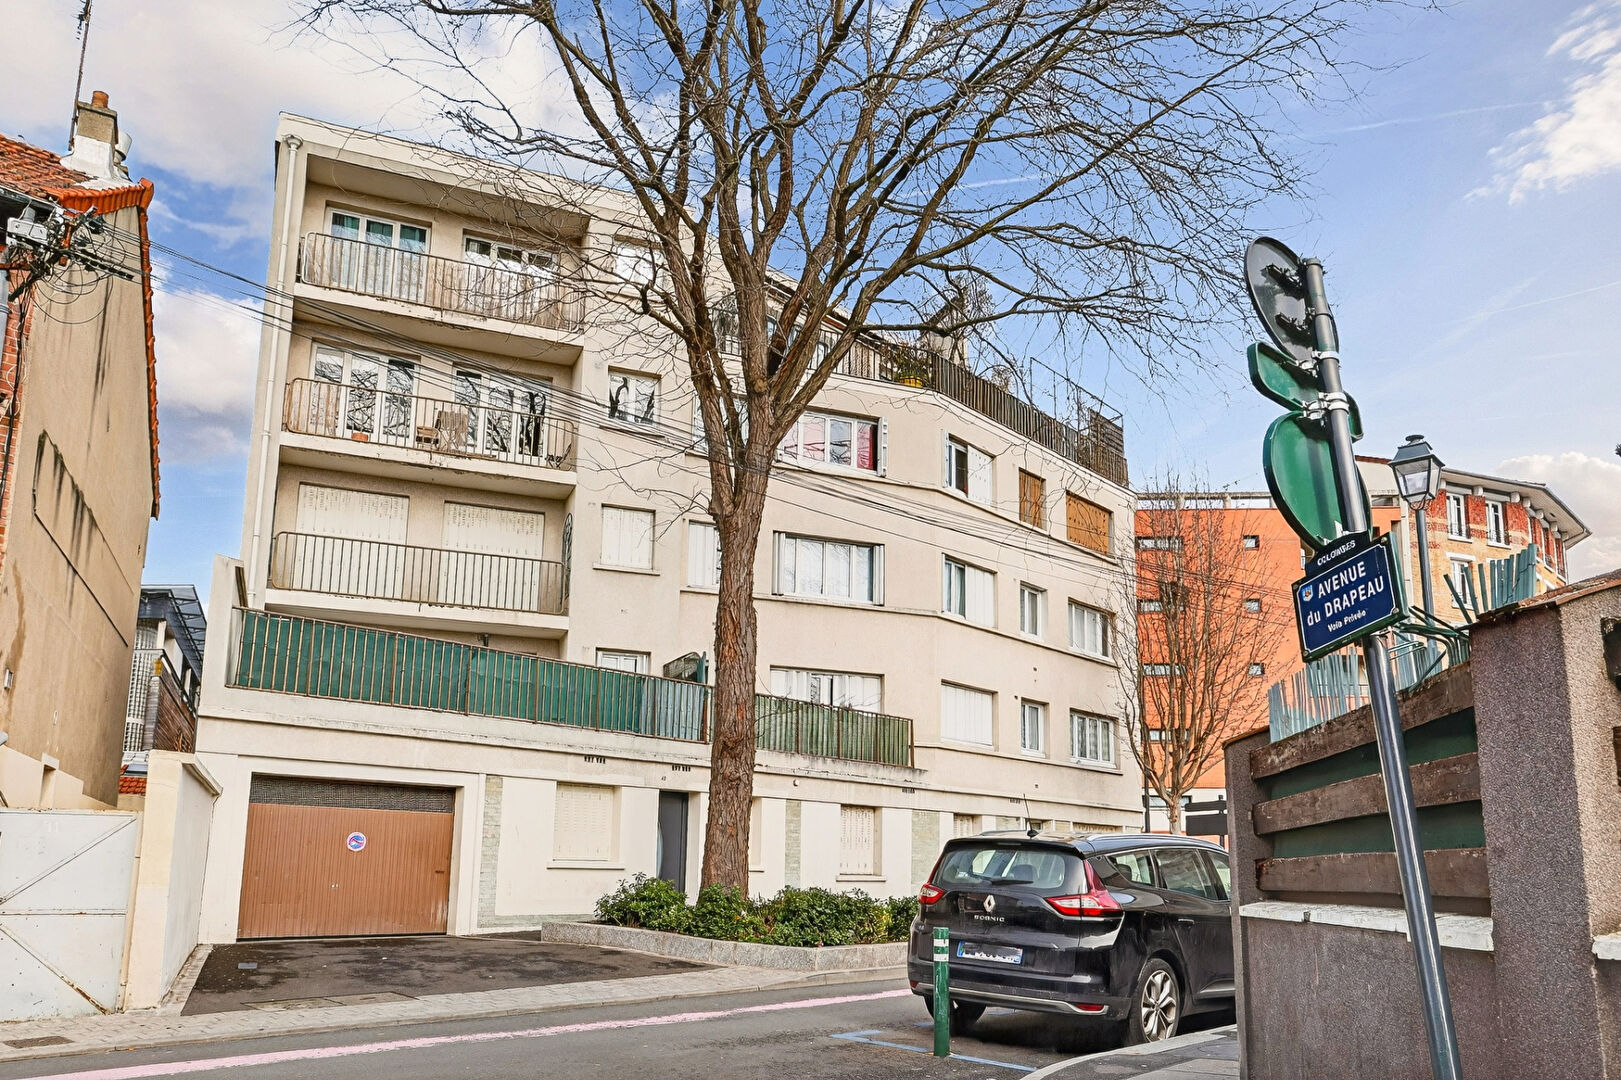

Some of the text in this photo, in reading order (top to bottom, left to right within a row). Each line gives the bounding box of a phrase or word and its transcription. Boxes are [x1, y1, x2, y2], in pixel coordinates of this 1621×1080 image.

[1317, 540, 1356, 566] COLOMBES
[1318, 561, 1366, 599] AVENUE
[1307, 575, 1384, 626] du DRAPEAU
[1327, 619, 1343, 632] Voie
